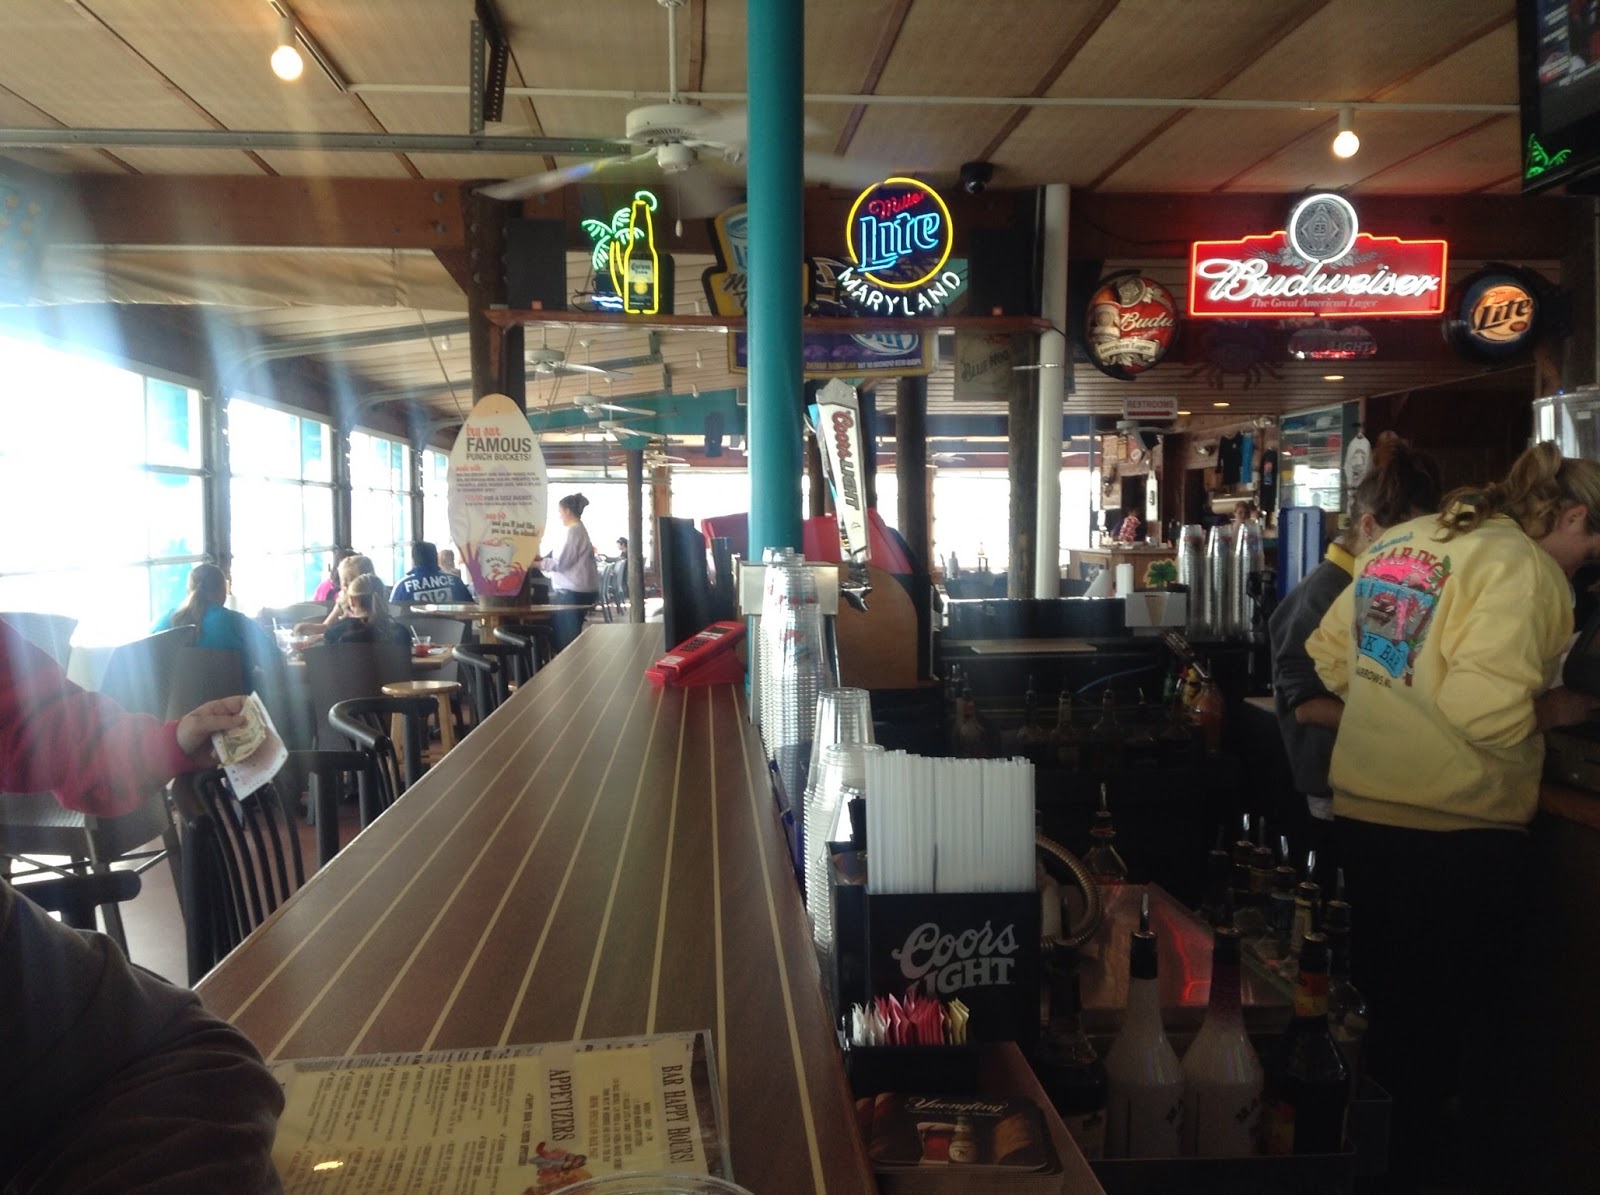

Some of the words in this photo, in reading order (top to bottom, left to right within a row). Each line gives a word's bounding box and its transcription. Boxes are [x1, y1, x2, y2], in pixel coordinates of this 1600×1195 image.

[868, 189, 928, 219] Miller
[857, 212, 941, 272] Lite
[837, 266, 961, 316] MARYLAND
[1196, 257, 1441, 302] Budweiser
[1250, 297, 1269, 308] The
[1271, 297, 1299, 308] Great
[1301, 297, 1347, 308] American
[1348, 297, 1378, 309] Lager
[1471, 298, 1533, 334] Lite
[1131, 342, 1153, 353] Lager
[1127, 398, 1175, 410] RESTROOMS
[466, 437, 532, 453] FAMOUS
[831, 410, 855, 460] Coors
[466, 453, 493, 461] PUNCH
[494, 452, 532, 462] BUCKETS!
[839, 458, 860, 511] LIGHT
[404, 575, 456, 593] FRANCE
[891, 920, 1019, 979] Coors
[923, 957, 1016, 995] IGHT
[661, 1065, 688, 1085] BAR
[549, 1069, 576, 1142] APPETIZERS
[664, 1090, 689, 1123] HAPPY
[904, 1096, 1008, 1113] Yuengling
[667, 1128, 695, 1163] HOURS!
